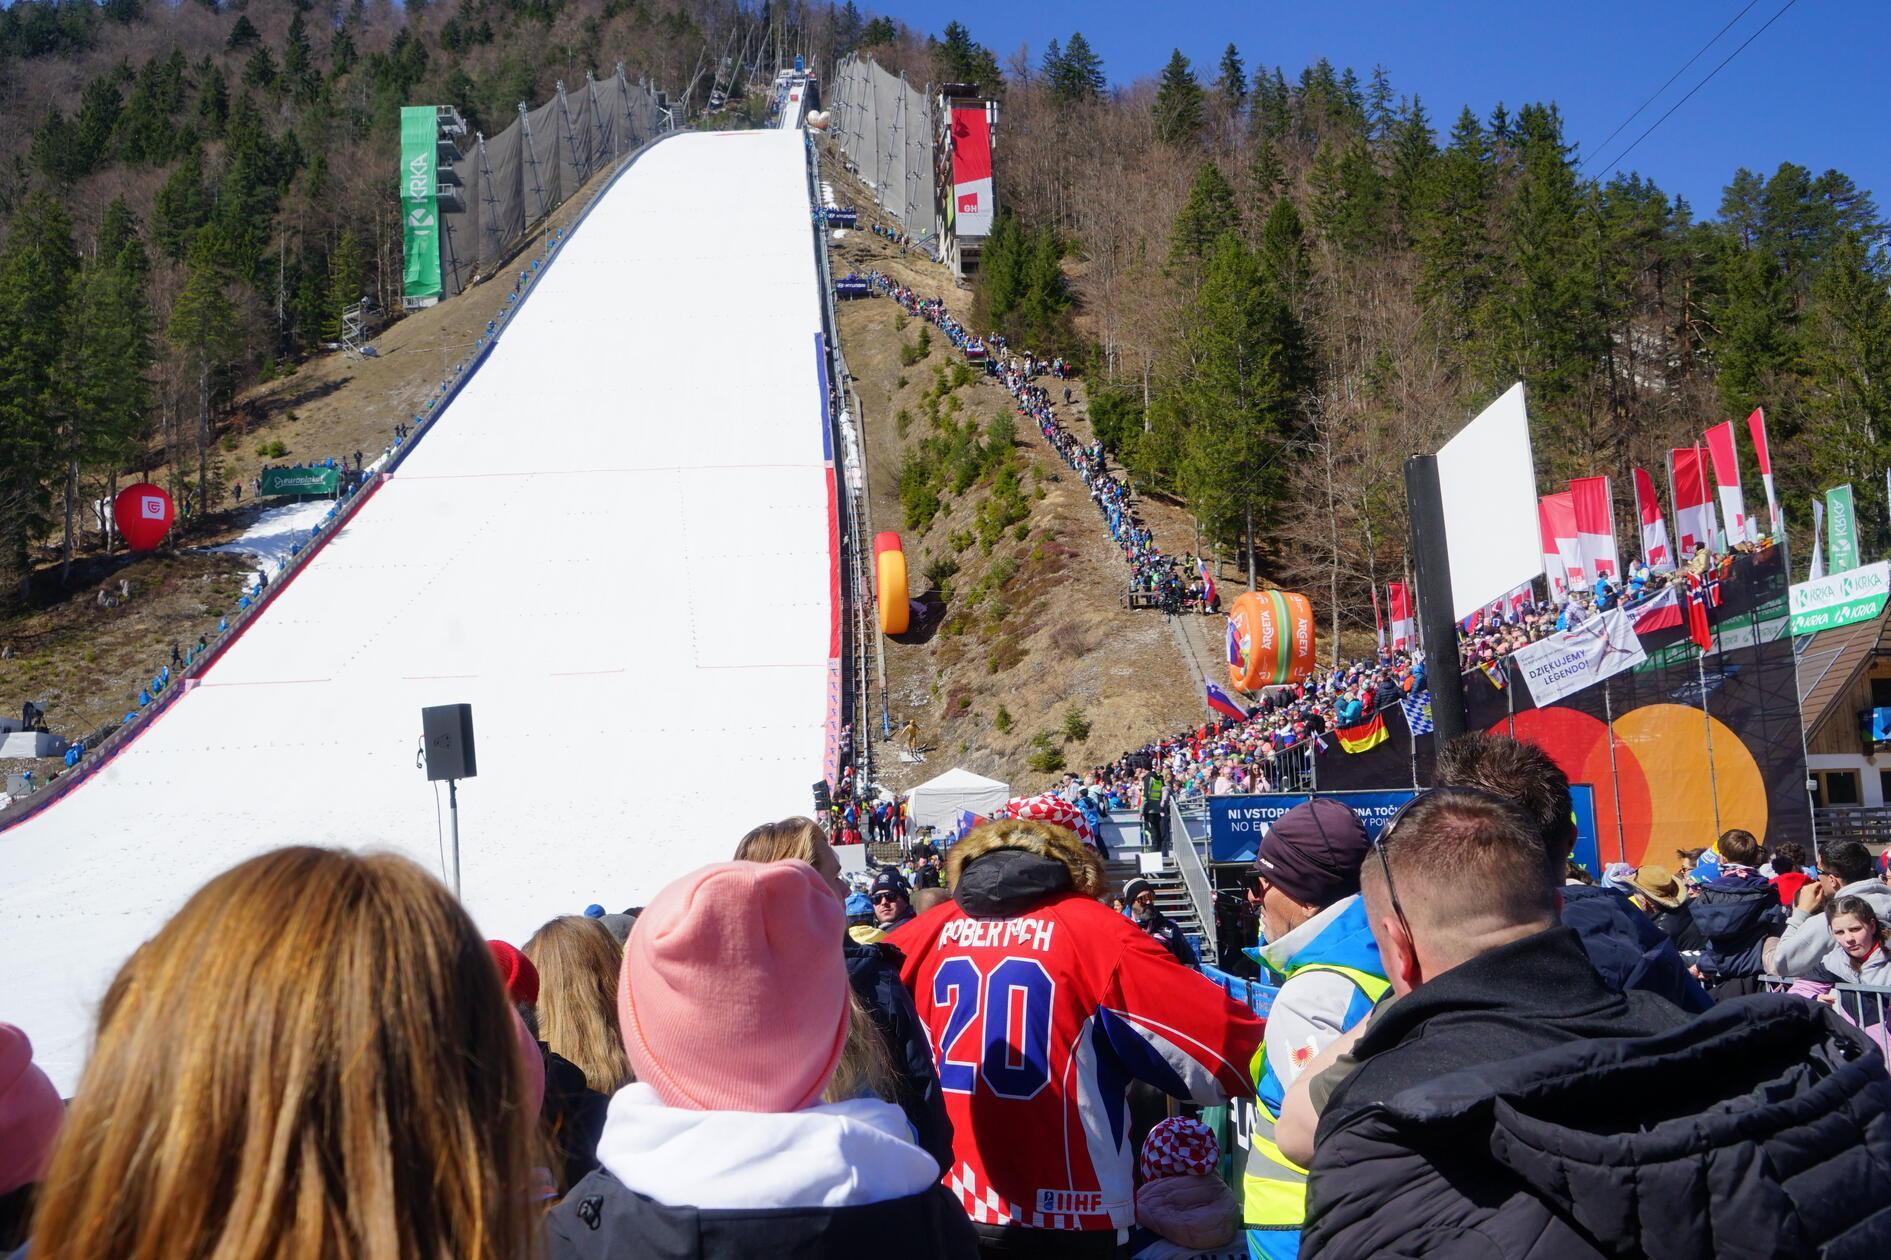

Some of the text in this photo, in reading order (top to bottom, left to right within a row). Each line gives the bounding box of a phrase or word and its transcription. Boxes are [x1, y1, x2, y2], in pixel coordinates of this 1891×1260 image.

[410, 151, 428, 203] KRKA
[963, 204, 977, 213] GH
[1855, 573, 1882, 591] KRKA
[1810, 584, 1836, 601] KRKA
[1850, 602, 1877, 619] KRKA
[1804, 613, 1829, 628] KRKA
[1261, 610, 1275, 651] ARGETA
[1295, 617, 1309, 657] ARGETA
[1528, 649, 1586, 679] DZIĘKUJEMY
[1543, 660, 1589, 685] LEGENDO!
[1228, 809, 1241, 819] NI
[1231, 821, 1249, 832] NO
[933, 955, 1056, 1100] 20
[1057, 1193, 1102, 1213] IIHF
